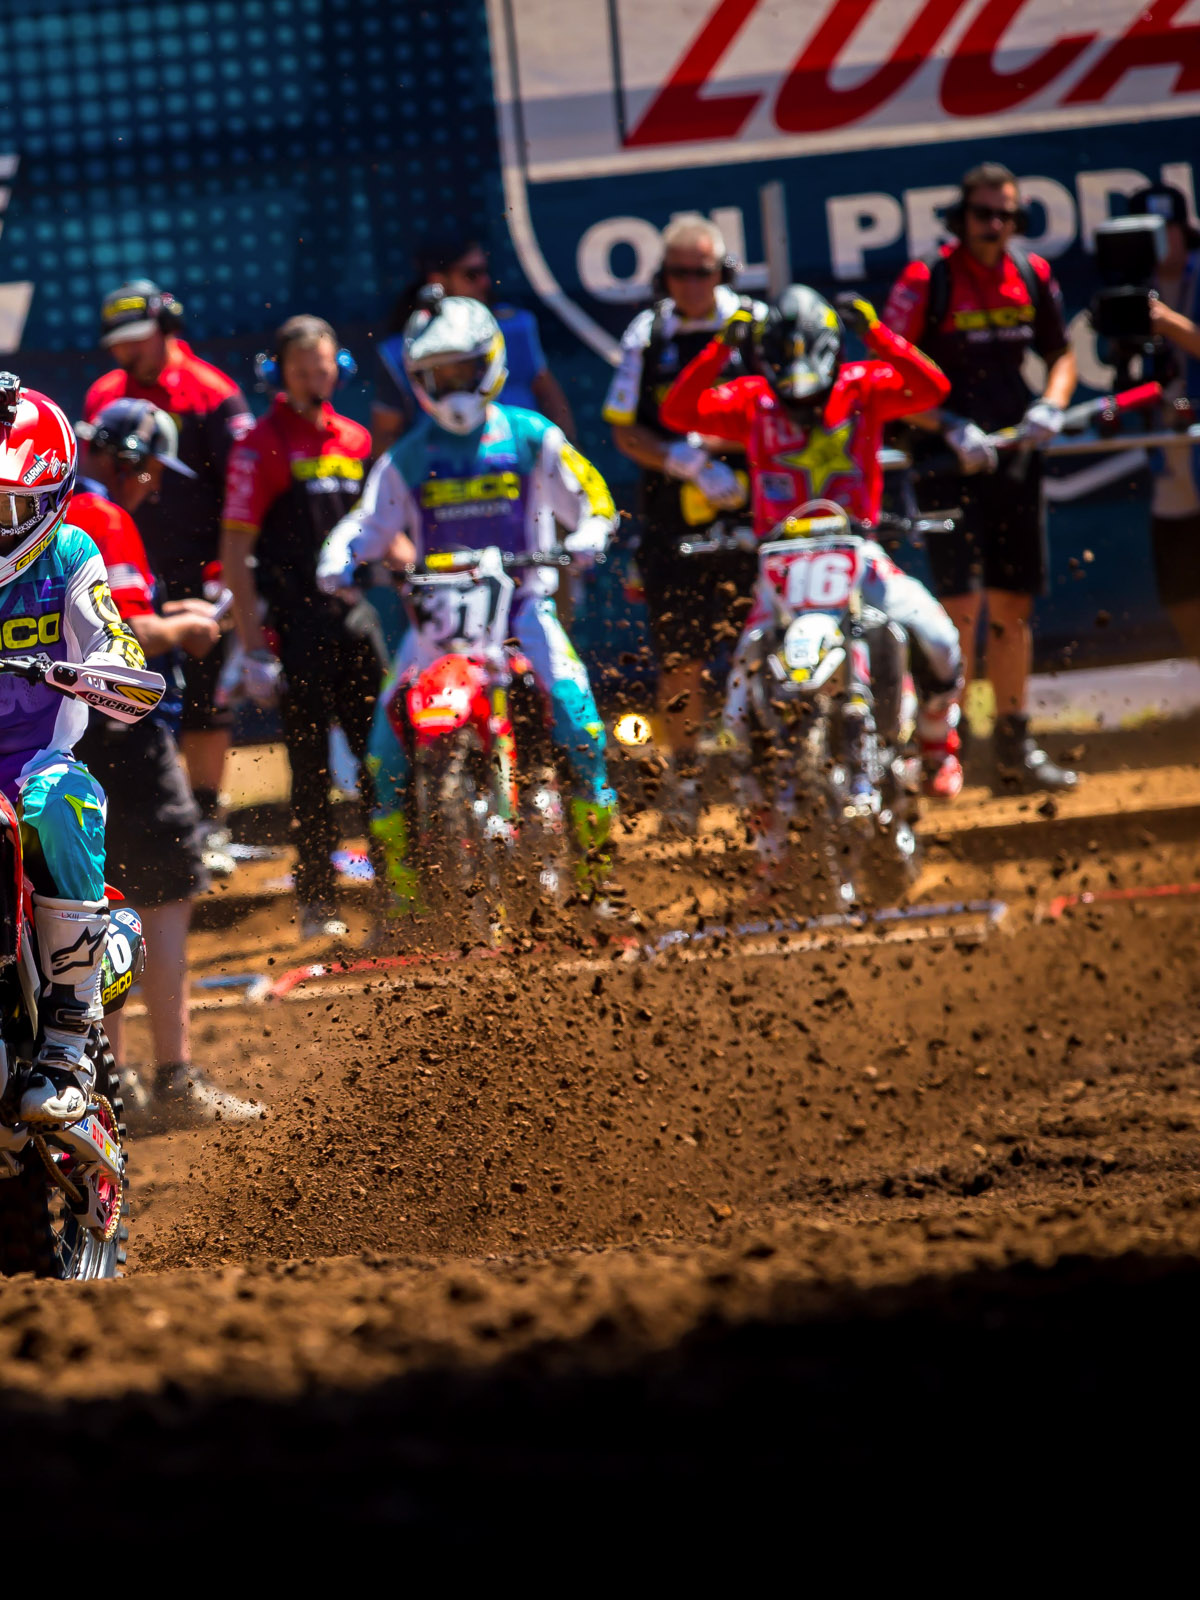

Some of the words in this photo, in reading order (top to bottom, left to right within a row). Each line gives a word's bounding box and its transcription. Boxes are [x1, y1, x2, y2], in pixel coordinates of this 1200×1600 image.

[22, 457, 49, 486] GARMIN
[785, 552, 850, 606] 16
[86, 692, 138, 715] CYCRA
[101, 970, 133, 1006] GEICO
